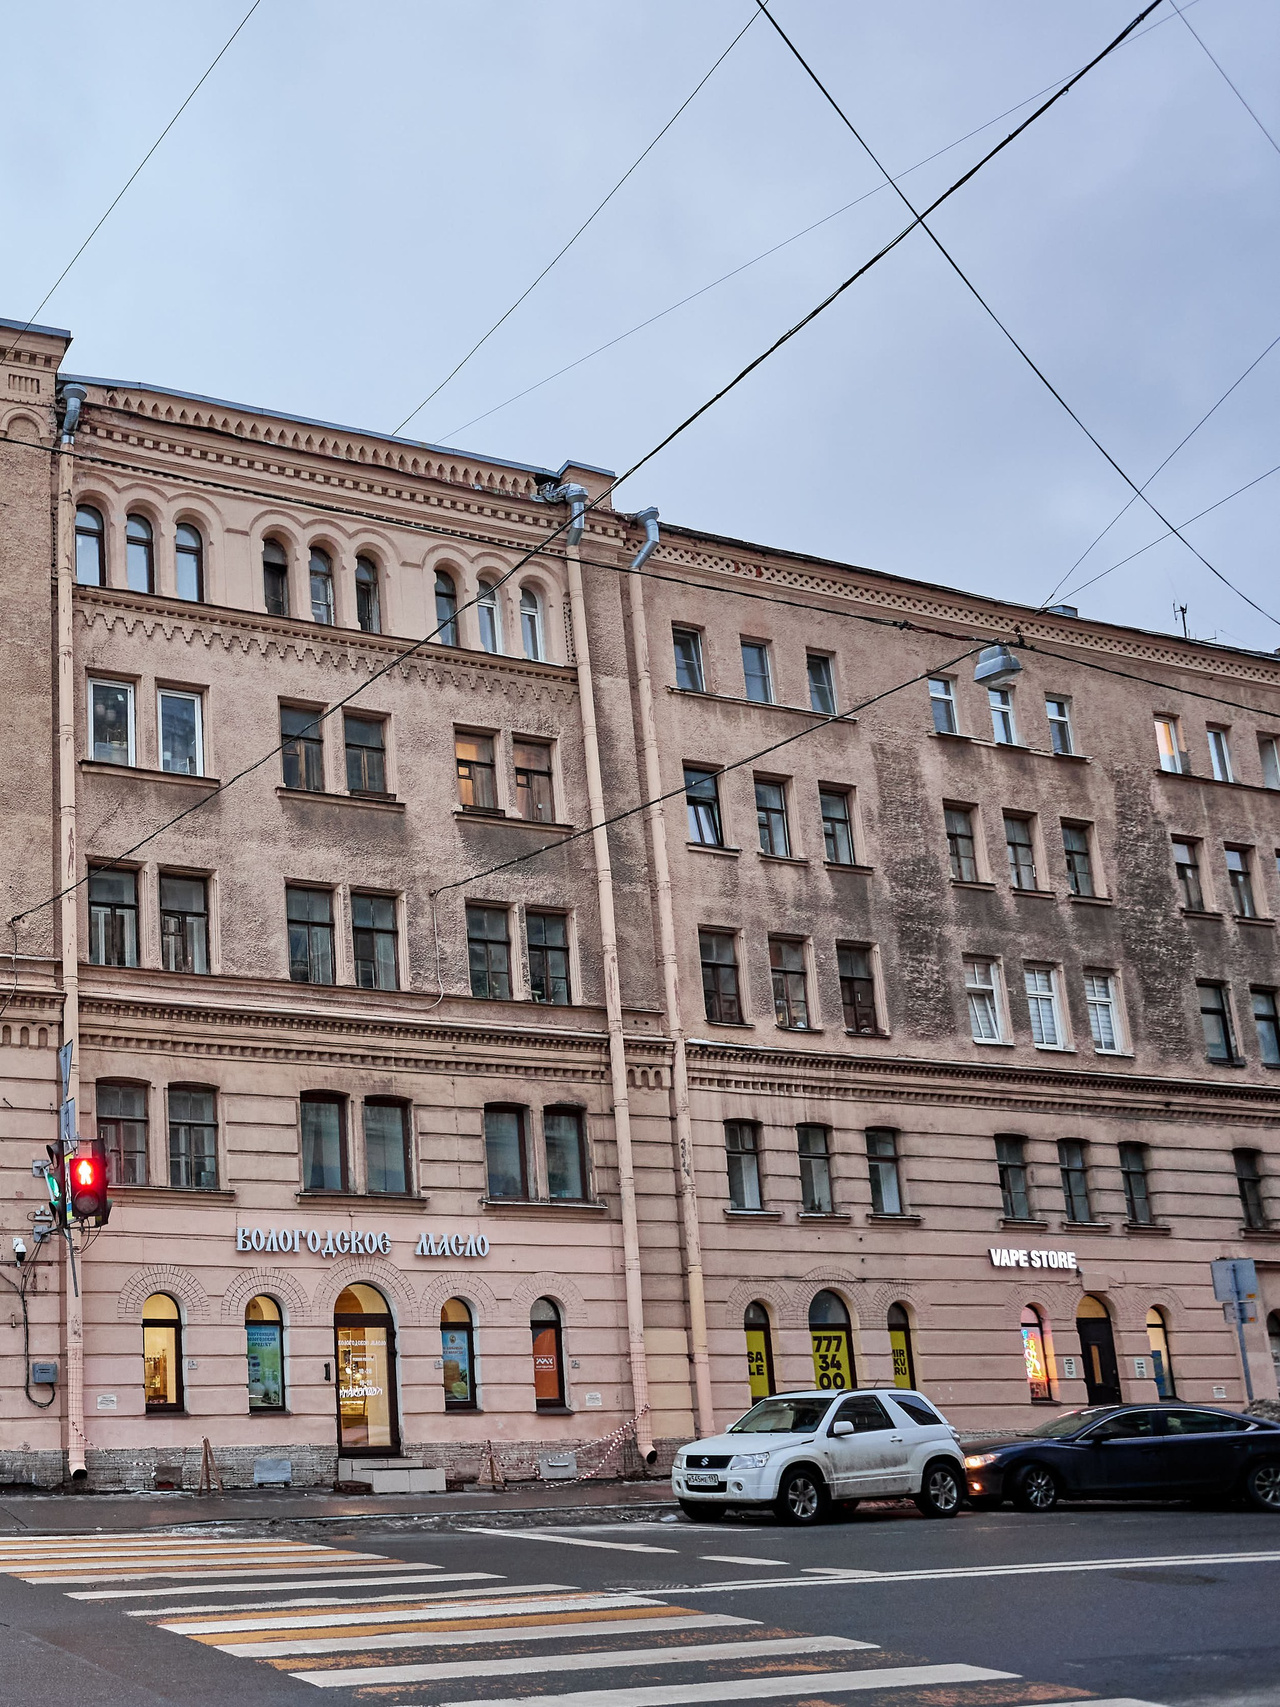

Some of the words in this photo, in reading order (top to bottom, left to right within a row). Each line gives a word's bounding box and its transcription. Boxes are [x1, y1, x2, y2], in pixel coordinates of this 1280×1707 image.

[236, 1227, 391, 1258] ВОЛОГОДСКОЕ
[415, 1232, 490, 1257] МАСЛО
[988, 1248, 1029, 1268] VAPE
[1030, 1249, 1077, 1269] STORE
[813, 1335, 842, 1353] 777
[747, 1351, 764, 1363] SA
[819, 1354, 842, 1371] 34
[748, 1364, 764, 1376] LE
[894, 1366, 907, 1376] RU
[819, 1372, 846, 1390] 00
